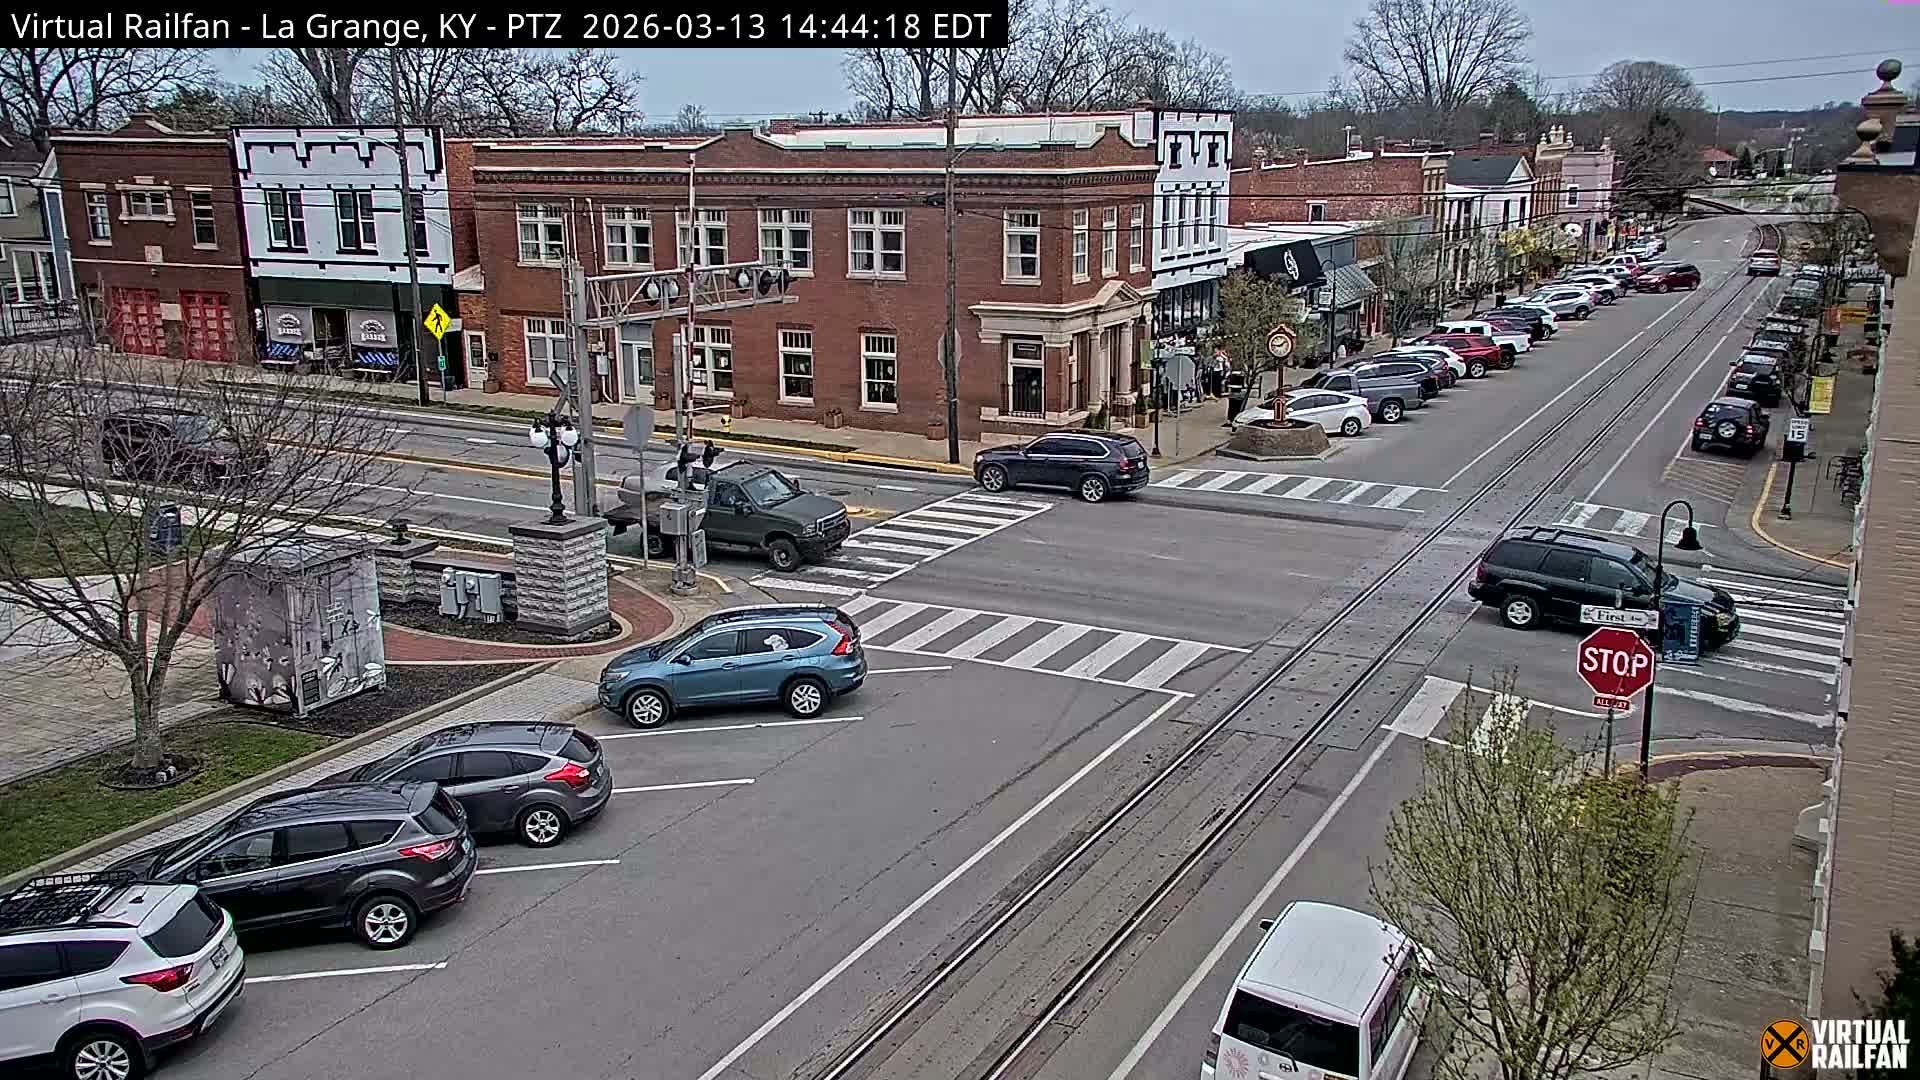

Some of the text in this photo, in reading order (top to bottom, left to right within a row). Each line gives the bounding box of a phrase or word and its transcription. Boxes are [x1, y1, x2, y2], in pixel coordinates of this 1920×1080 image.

[1791, 430, 1805, 440] 15
[1597, 610, 1625, 622] First
[1583, 647, 1648, 677] STOP
